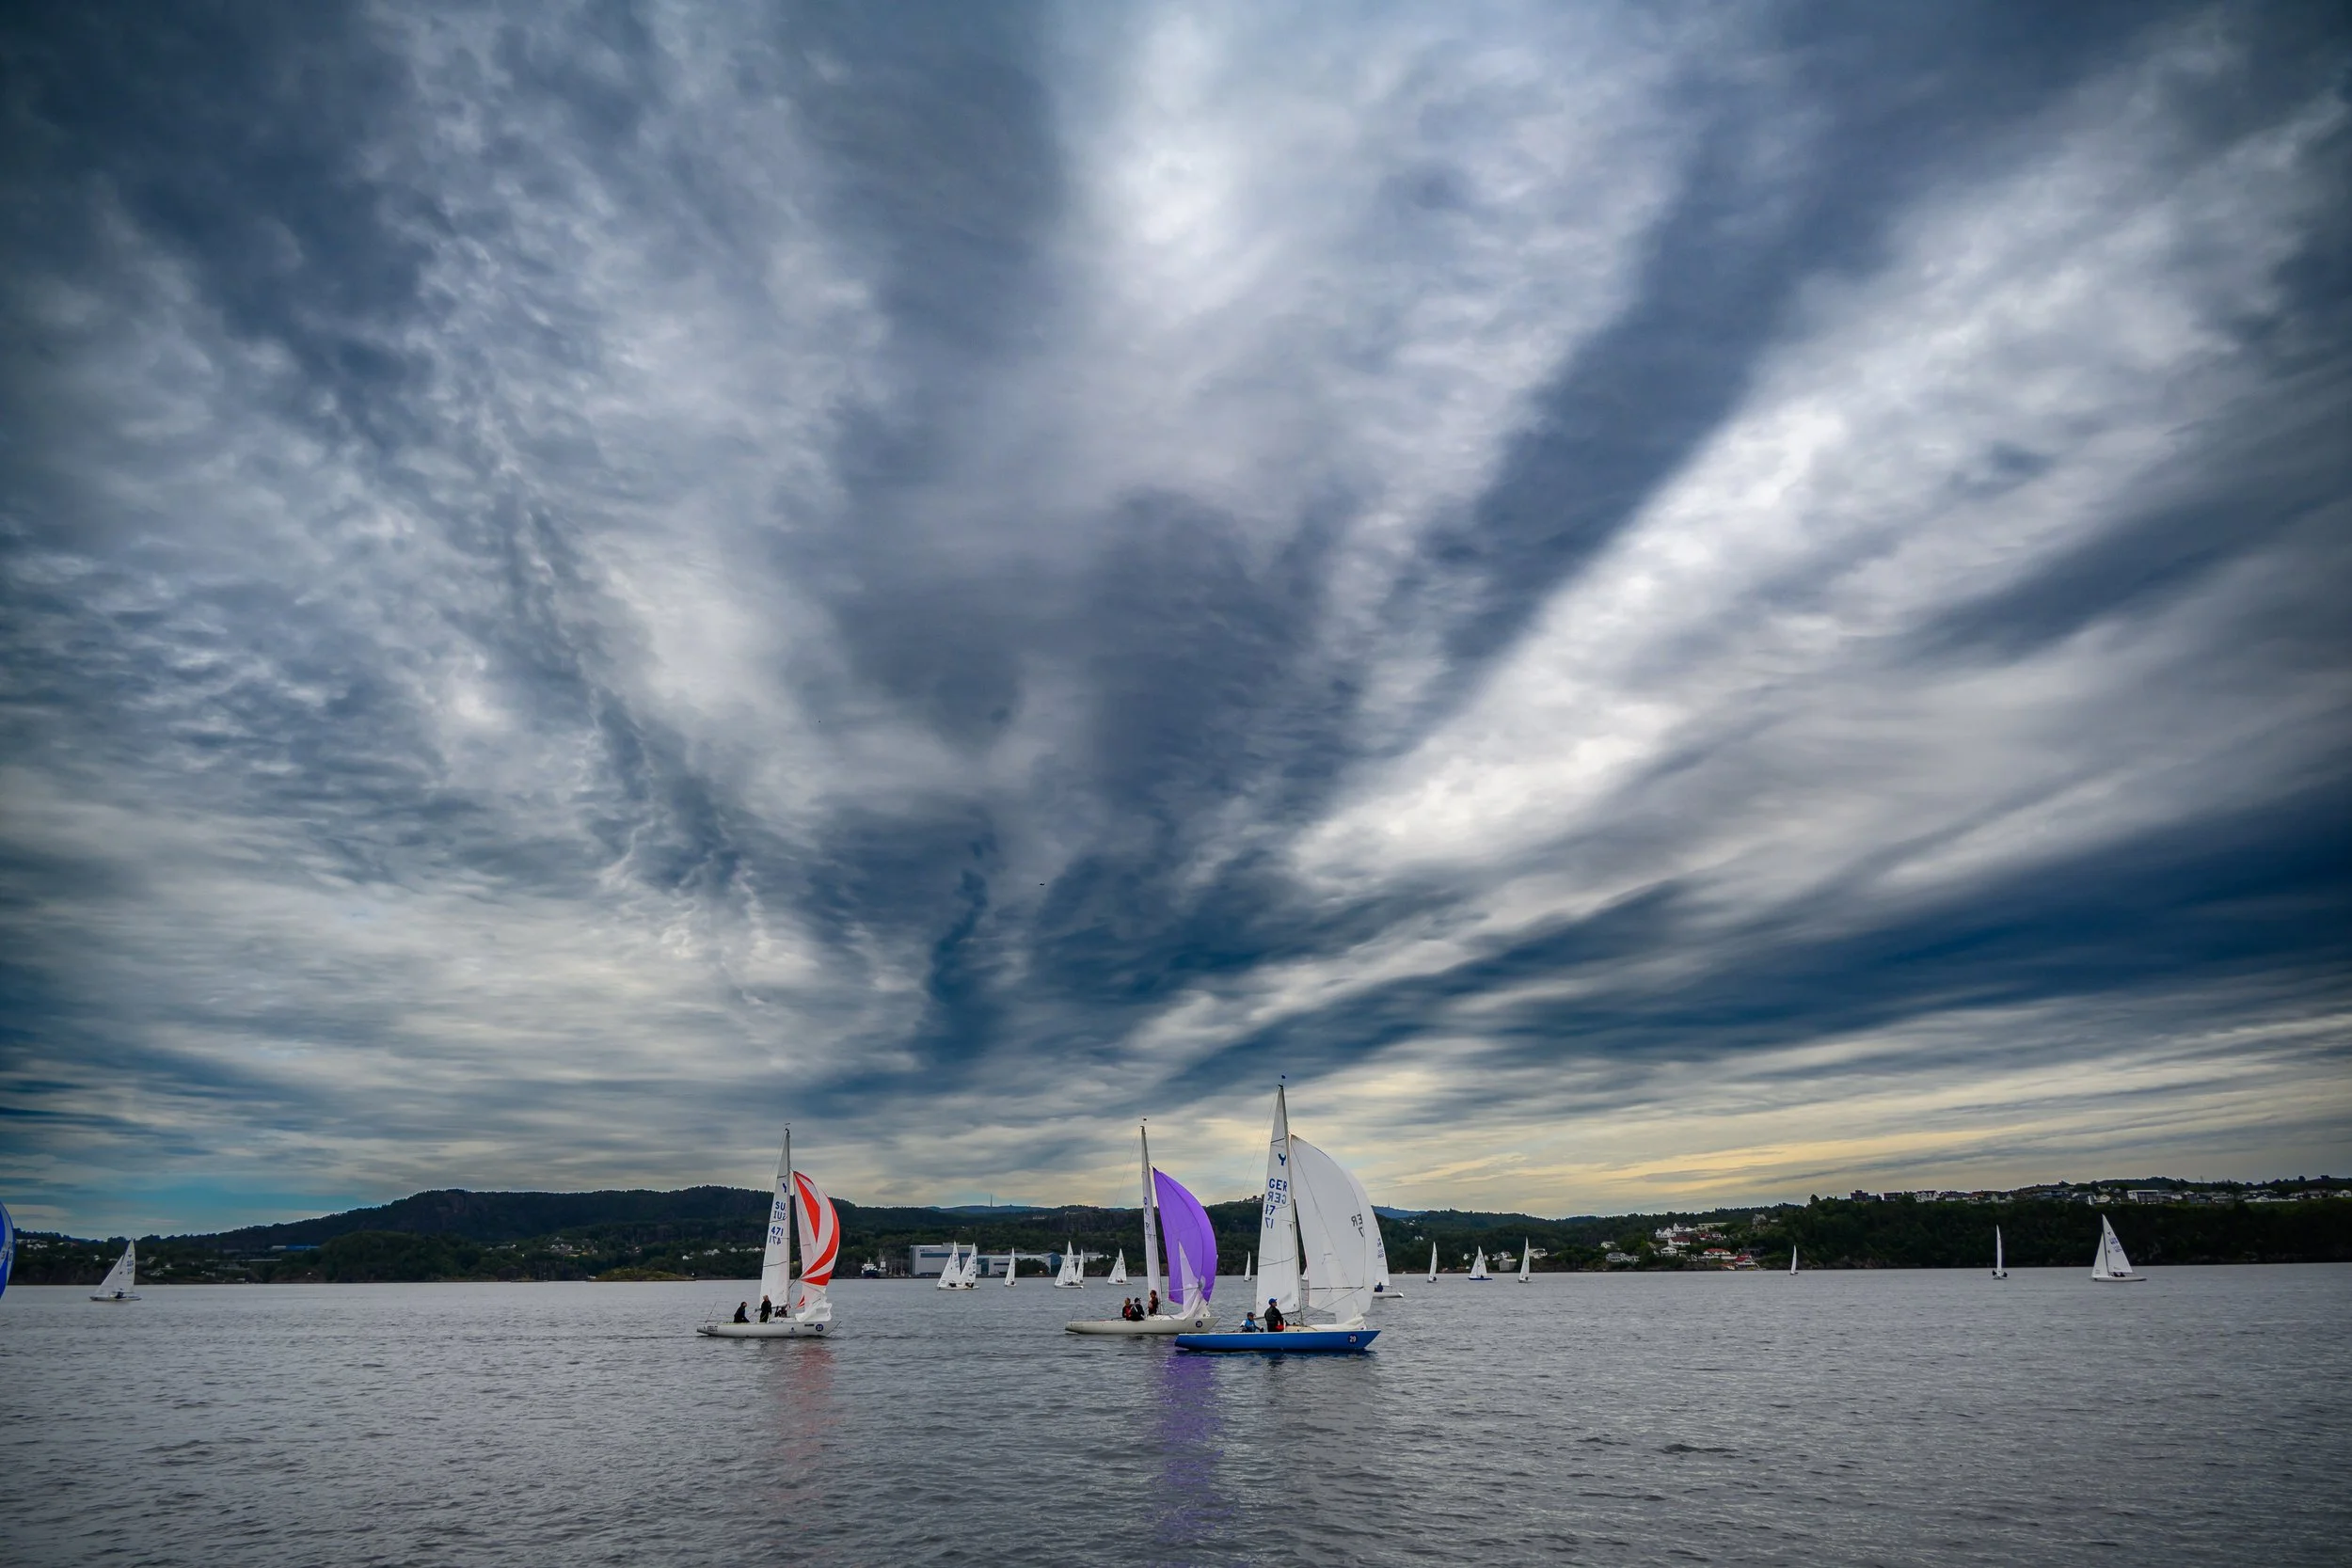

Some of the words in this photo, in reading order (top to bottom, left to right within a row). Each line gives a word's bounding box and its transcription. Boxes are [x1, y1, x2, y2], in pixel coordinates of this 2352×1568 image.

[1269, 1178, 1287, 1192] GER
[775, 1201, 786, 1211] SU
[1265, 1204, 1275, 1215] 17
[771, 1226, 783, 1236] 471
